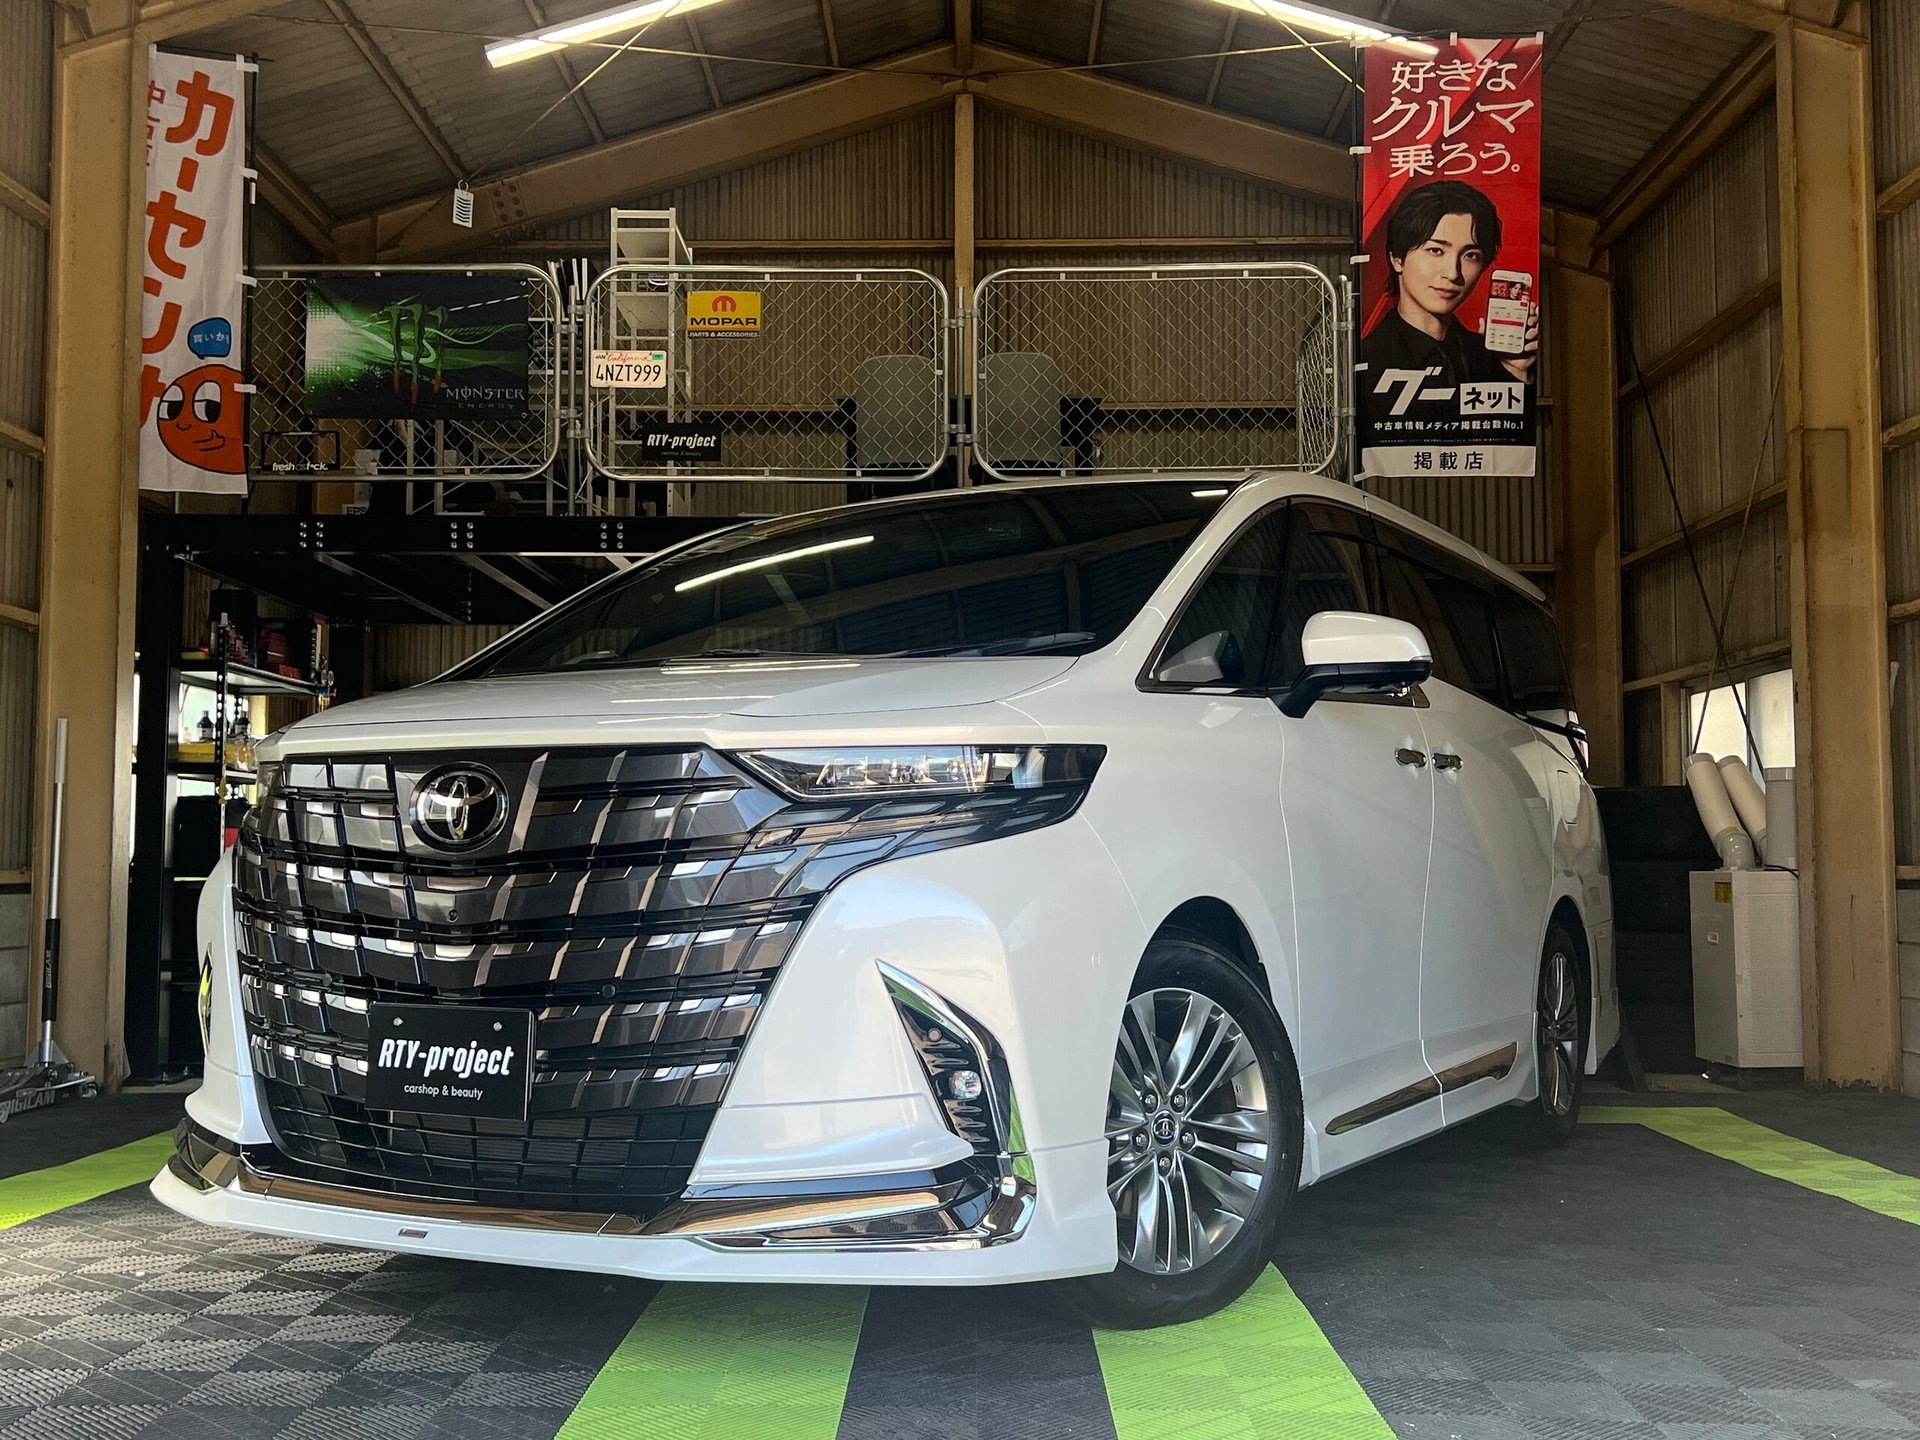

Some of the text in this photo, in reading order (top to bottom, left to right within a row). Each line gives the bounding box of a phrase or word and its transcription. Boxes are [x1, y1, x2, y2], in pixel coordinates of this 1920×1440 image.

[1391, 59, 1518, 95] 好きな
[1371, 95, 1535, 142] クルマ
[1388, 141, 1521, 179] 乗ろう。
[690, 317, 758, 327] MOPAR
[595, 364, 662, 383] 4NZT999
[446, 385, 526, 401] MONSTER
[646, 433, 717, 449] RTY-project
[1414, 451, 1484, 471] 掲載店
[378, 1039, 514, 1078] RTY-project
[404, 1083, 483, 1100] carshop & beauty
